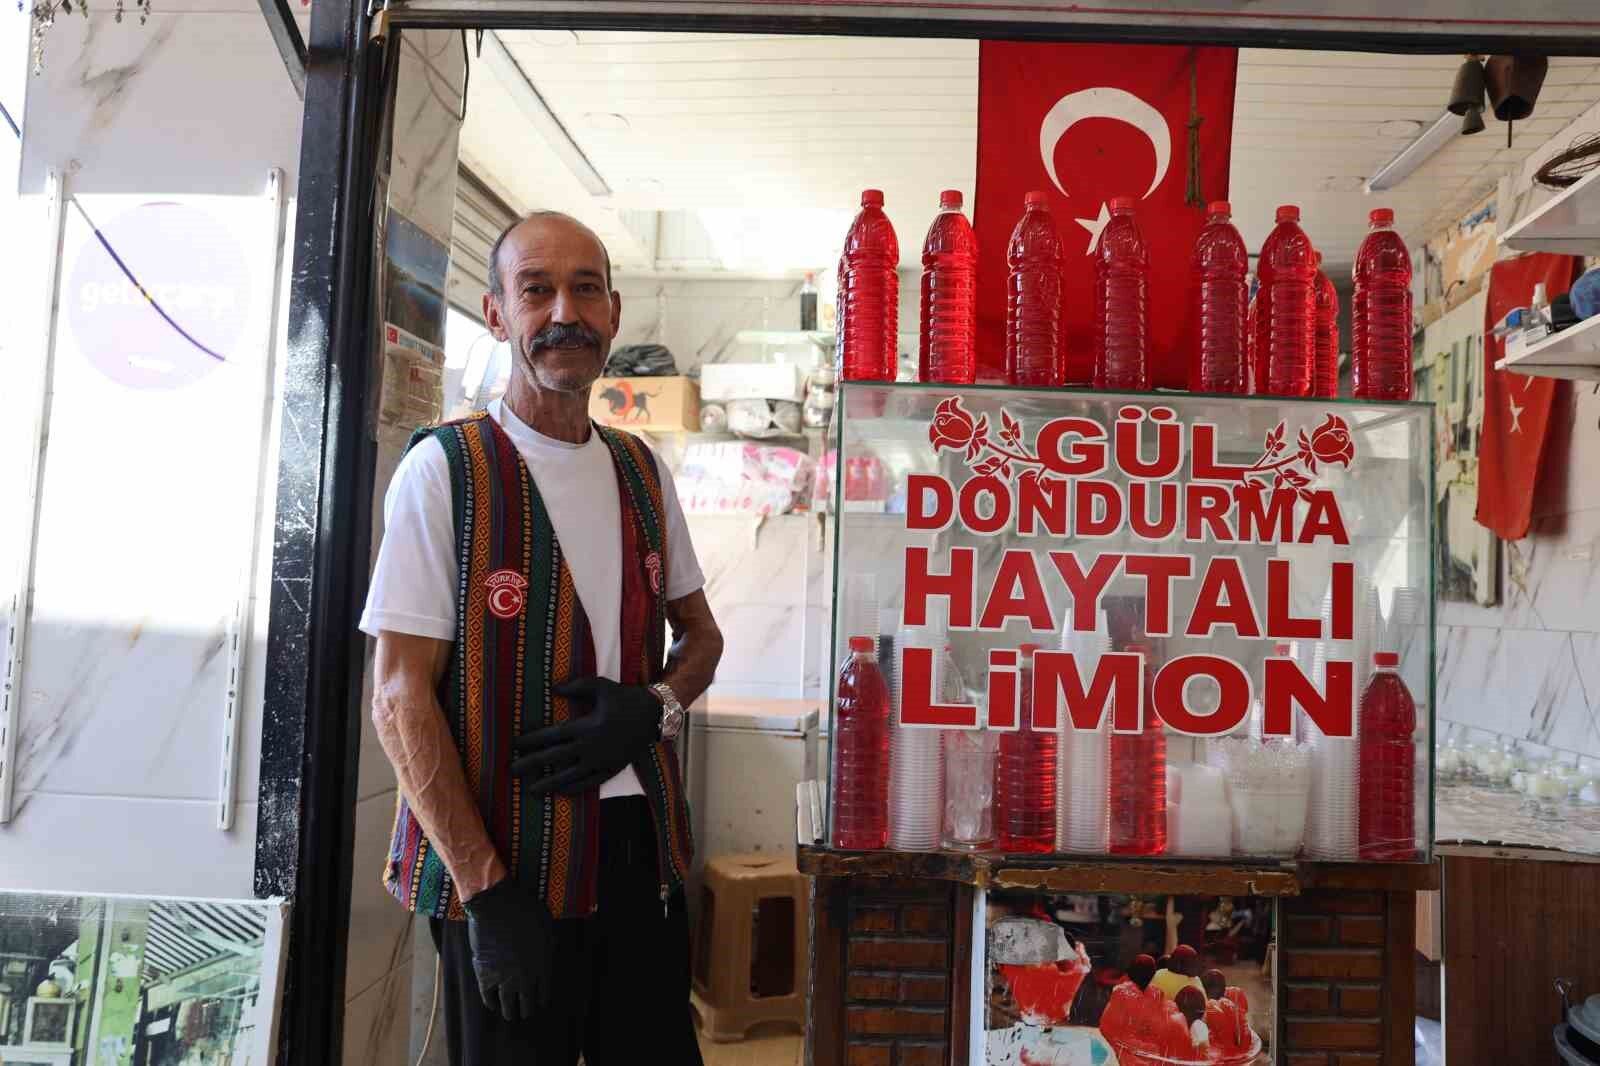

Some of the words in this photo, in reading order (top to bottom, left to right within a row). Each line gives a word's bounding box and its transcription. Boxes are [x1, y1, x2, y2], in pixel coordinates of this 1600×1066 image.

[1035, 406, 1248, 481] GÜL
[906, 474, 1350, 544] DONDURMA
[904, 547, 1355, 640] HAYTALI
